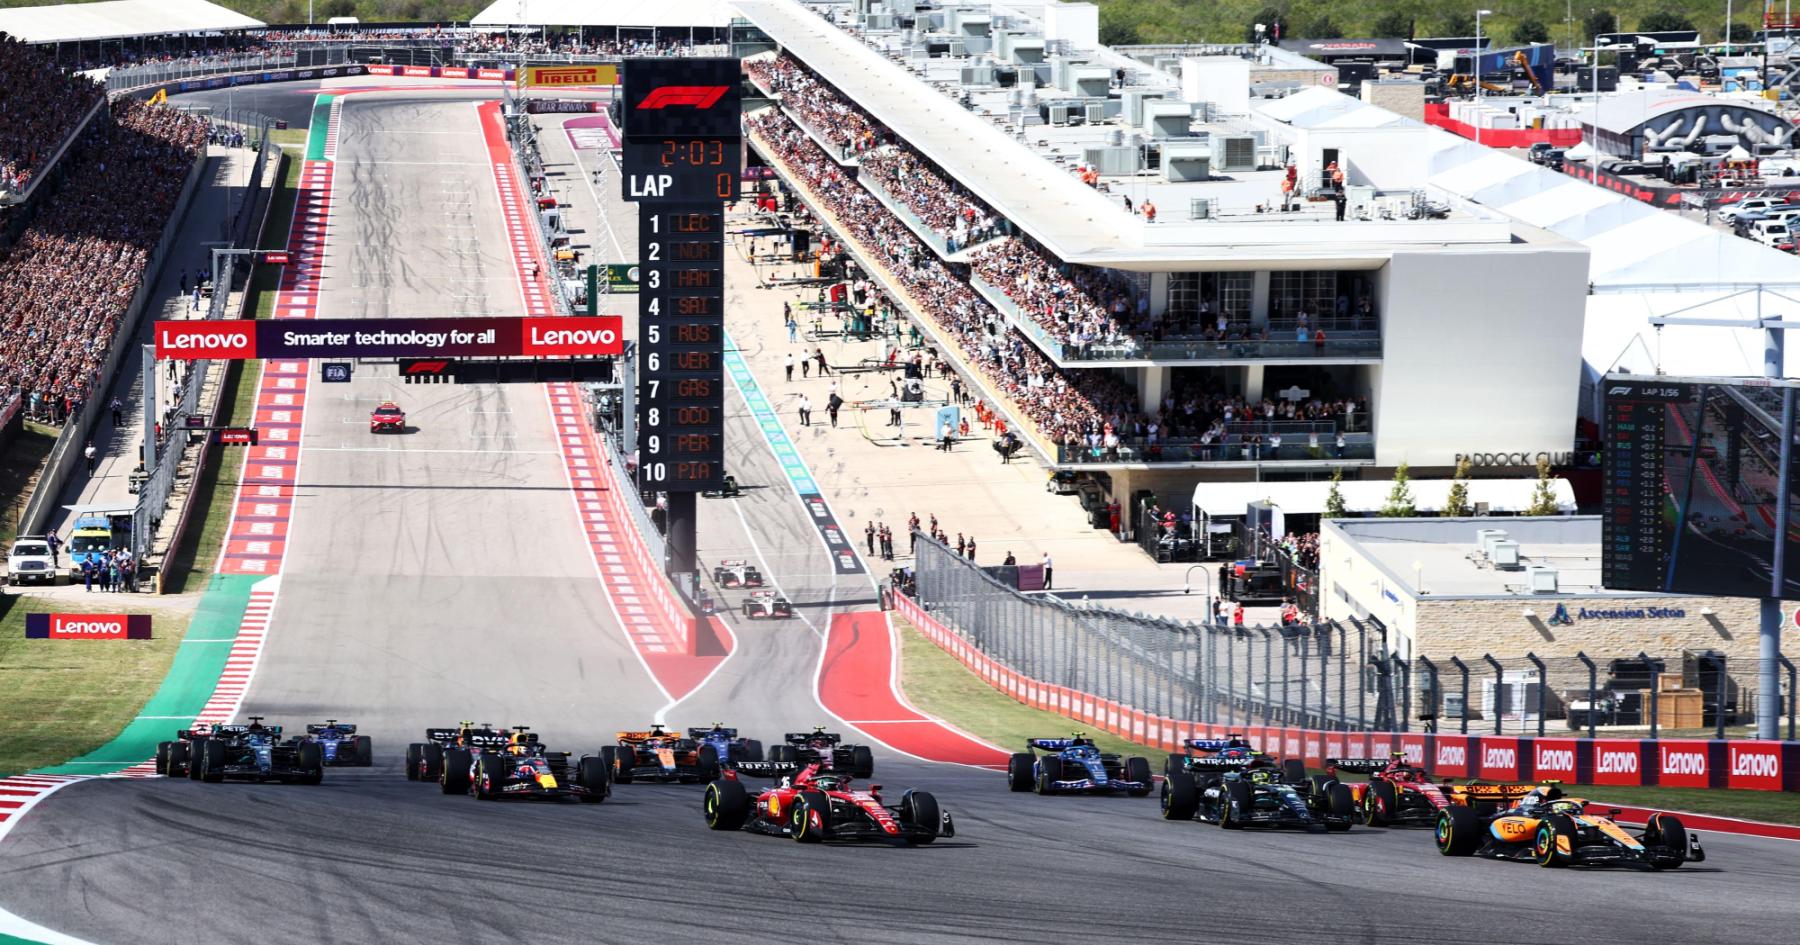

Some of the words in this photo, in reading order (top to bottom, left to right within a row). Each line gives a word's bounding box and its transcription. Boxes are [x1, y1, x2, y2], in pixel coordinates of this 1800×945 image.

[442, 69, 466, 77] Lenovo
[535, 69, 597, 84] PIRELLI
[661, 140, 722, 165] 2:03
[630, 175, 673, 197] LAP
[649, 214, 659, 233] 1
[678, 215, 710, 231] LEC
[648, 242, 660, 261] 2
[648, 270, 660, 288] 3
[678, 271, 710, 287] HAM
[648, 297, 660, 316] 4
[678, 298, 708, 314] SAI
[162, 330, 248, 349] Lenovo
[284, 331, 351, 347] Smarter
[355, 329, 447, 348] technology
[450, 329, 474, 345] for
[476, 329, 496, 344] all
[531, 327, 615, 346] Lenovo
[648, 325, 660, 343] 5
[678, 325, 710, 342] RUS
[648, 352, 660, 371] 6
[678, 353, 709, 369] VER
[648, 380, 660, 398] 7
[678, 380, 709, 397] GAS
[1641, 387, 1658, 395] LAP
[648, 408, 660, 426] 8
[678, 408, 709, 424] OCO
[648, 435, 660, 453] 9
[678, 436, 709, 452] PER
[1455, 452, 1530, 466] PADDOCK
[643, 463, 666, 481] 10
[678, 463, 709, 480] PIA
[1578, 607, 1645, 620] Ascension
[1647, 607, 1686, 619] Seton
[56, 619, 121, 633] Lenovo
[1437, 741, 1465, 766] Lenovo
[1482, 743, 1515, 769] Lenovo
[1536, 745, 1574, 771] Lenovo
[1596, 747, 1637, 774] Lenovo
[1662, 747, 1705, 775] Lenovo
[1732, 748, 1778, 777] Lenovo
